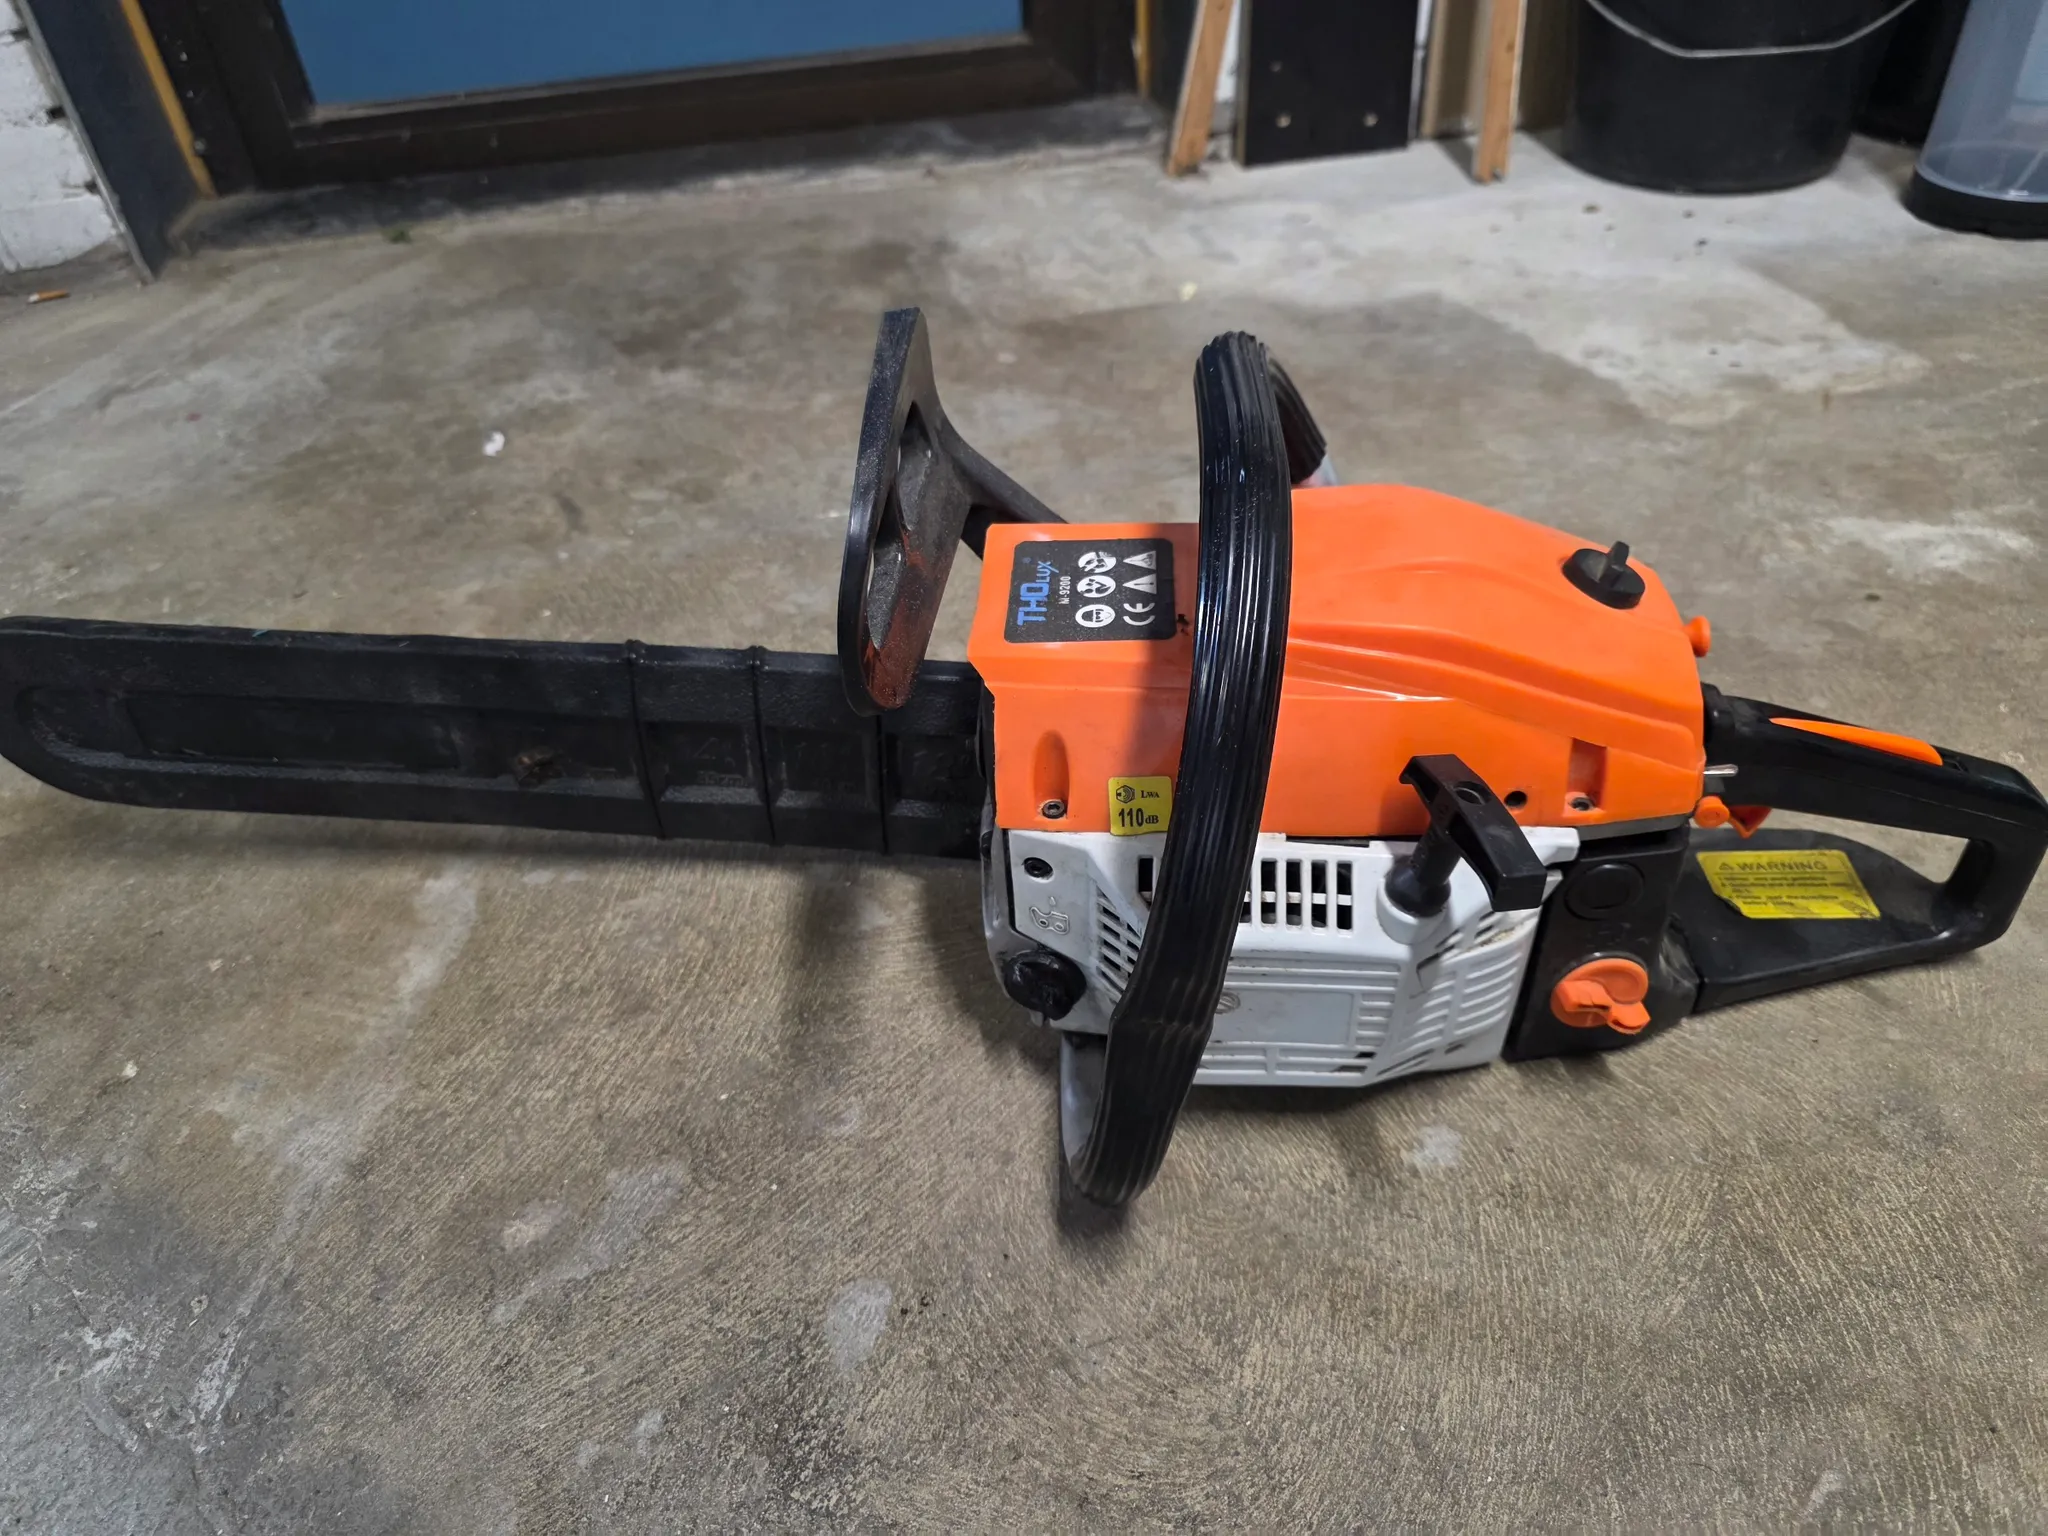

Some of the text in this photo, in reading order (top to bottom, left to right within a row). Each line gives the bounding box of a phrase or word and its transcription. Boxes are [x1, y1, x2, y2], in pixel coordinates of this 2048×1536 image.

[1059, 576, 1071, 605] M-9200
[1123, 602, 1156, 626] CE
[1737, 861, 1828, 871] WARNING
